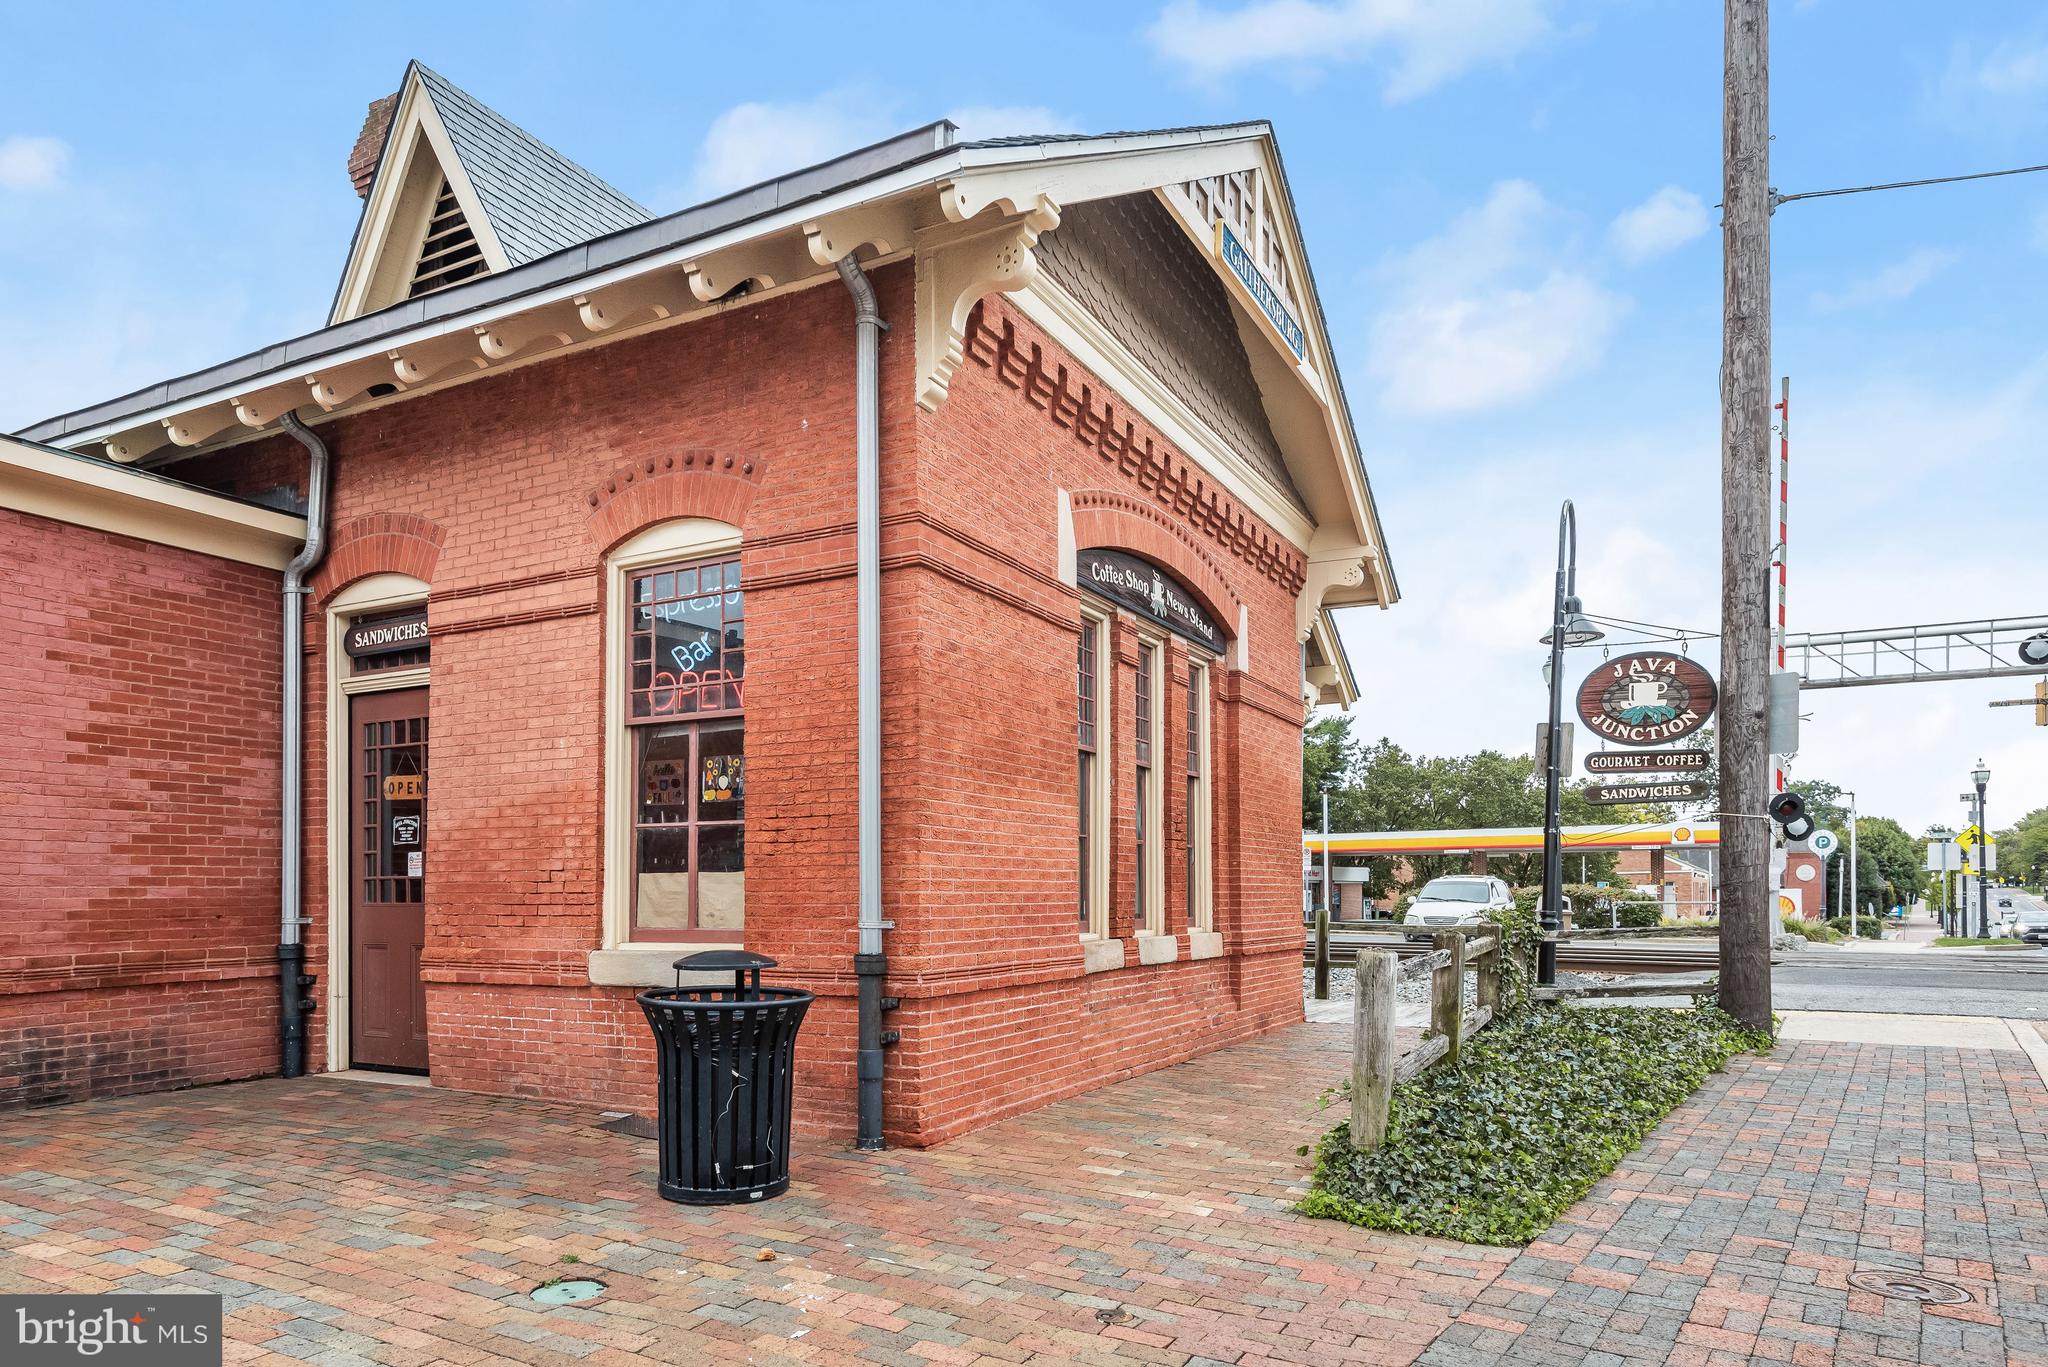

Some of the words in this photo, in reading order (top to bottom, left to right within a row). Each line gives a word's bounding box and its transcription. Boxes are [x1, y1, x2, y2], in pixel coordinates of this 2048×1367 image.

[1229, 241, 1299, 348] GAITHERSBURG
[1091, 562, 1124, 586] Coffee
[1125, 569, 1150, 597] Shop
[1166, 589, 1189, 619] News
[1189, 607, 1213, 640] Stand
[354, 621, 428, 648] SANDWICHES
[671, 631, 714, 672] Bar
[1613, 657, 1677, 678] JAVA
[648, 669, 745, 711] OPEN
[1591, 708, 1699, 741] JUNCTION
[1590, 755, 1650, 768] GOURMET
[1656, 754, 1703, 766] COFFEE
[388, 782, 423, 795] OPEN
[1600, 784, 1692, 800] SANDWICHES
[1818, 837, 1828, 848] P
